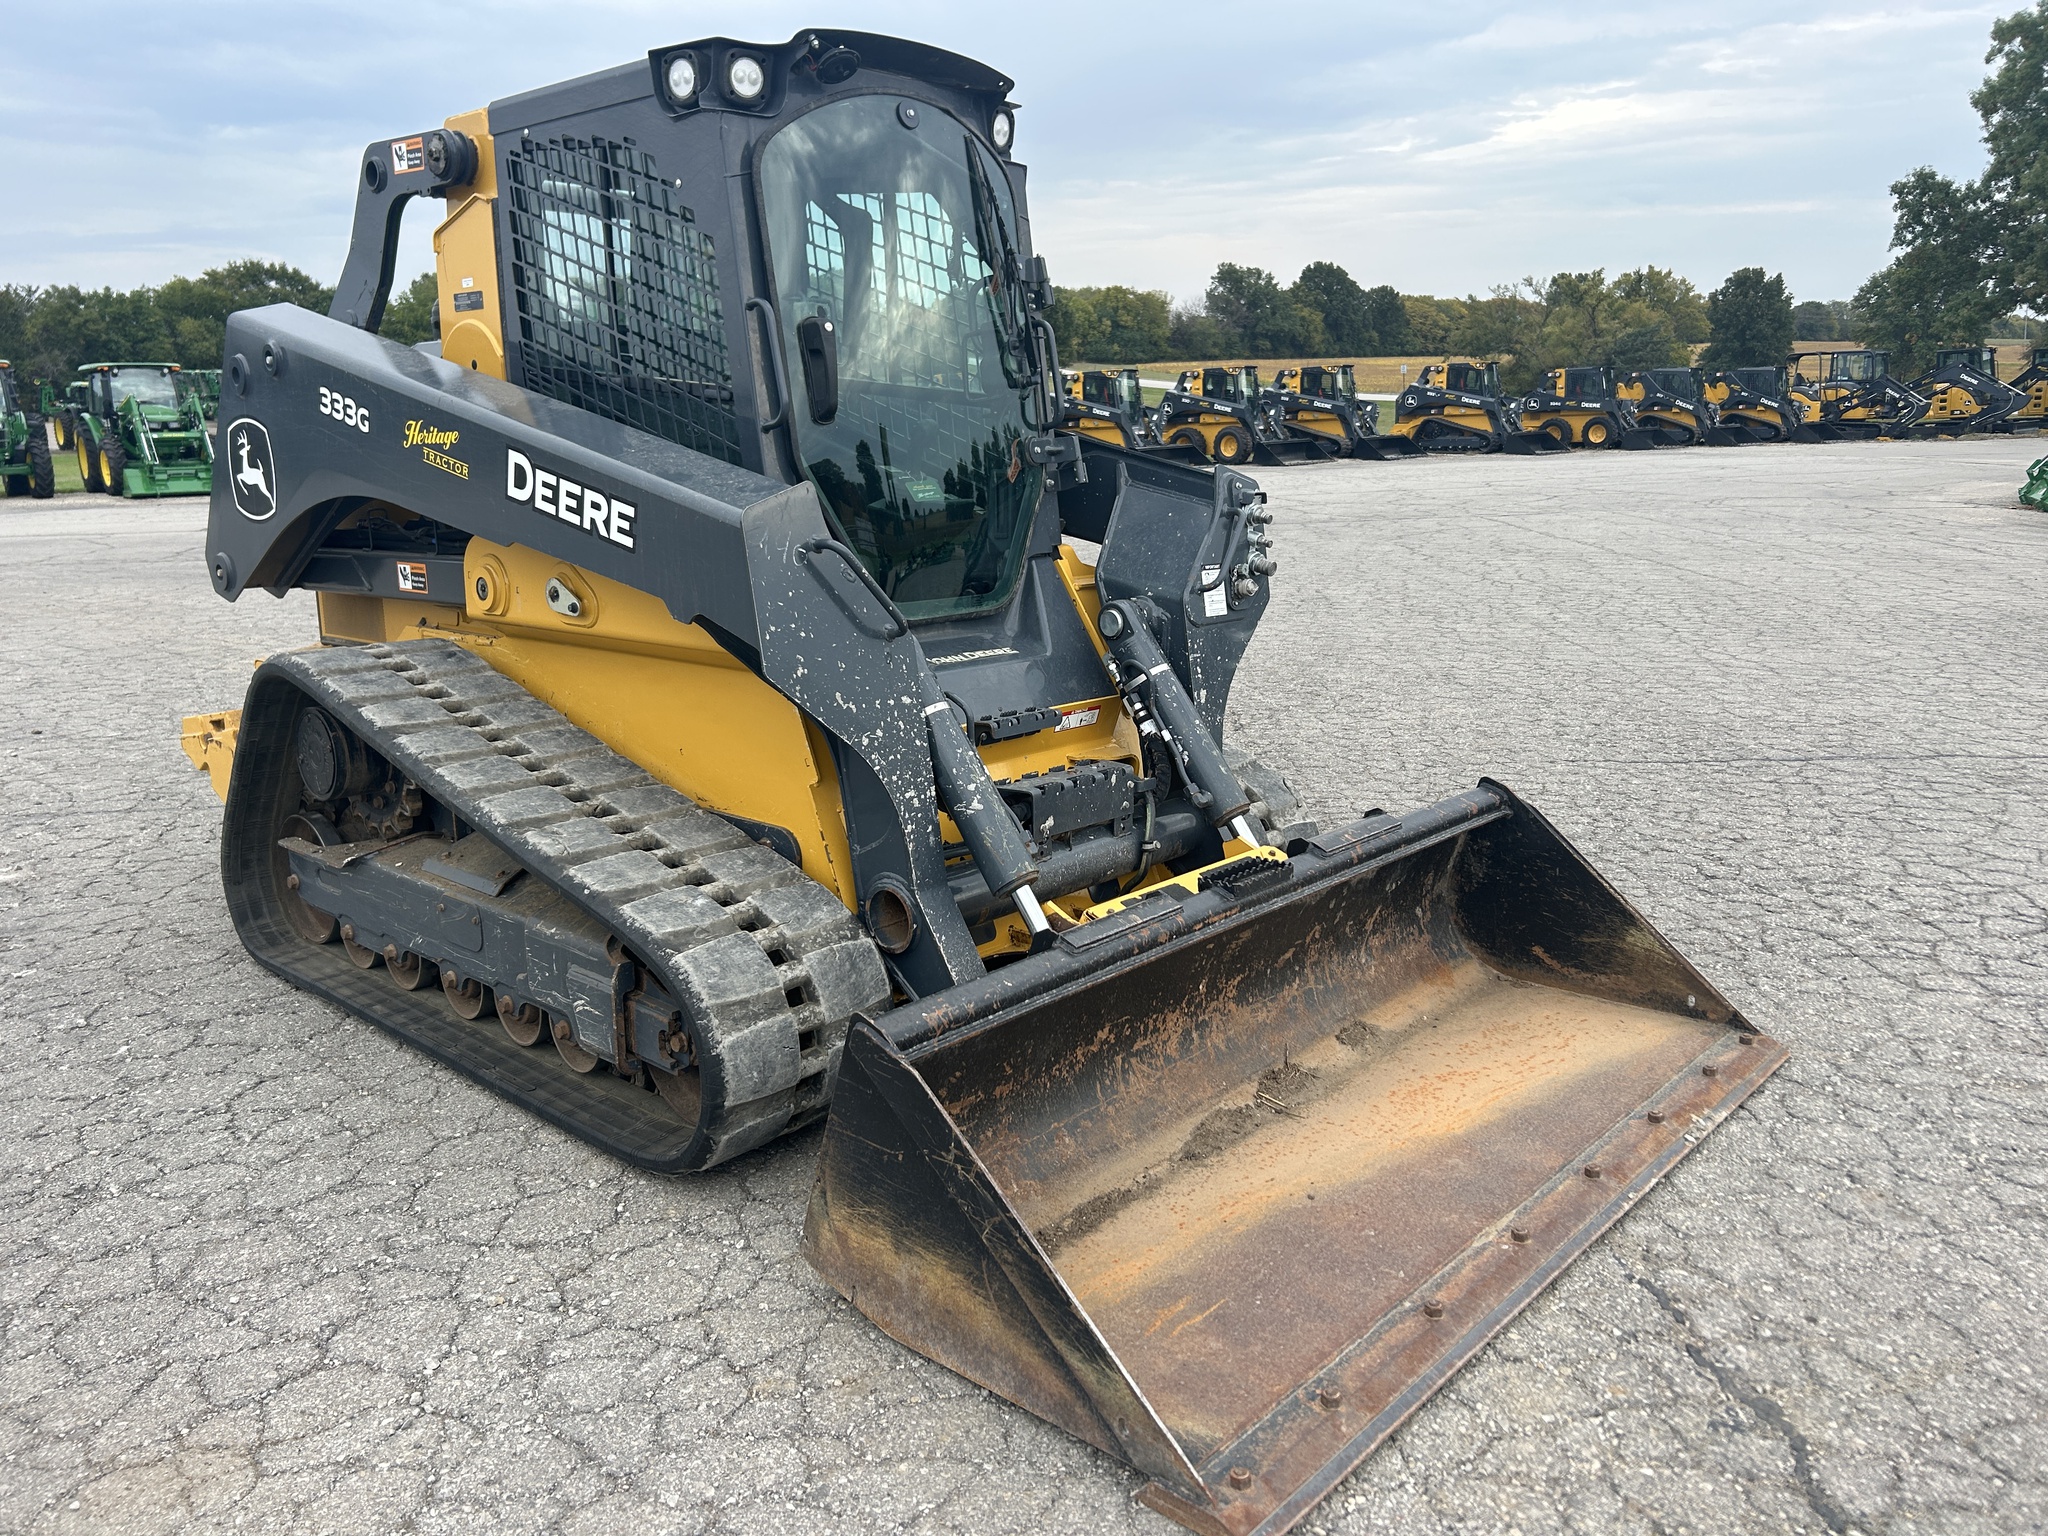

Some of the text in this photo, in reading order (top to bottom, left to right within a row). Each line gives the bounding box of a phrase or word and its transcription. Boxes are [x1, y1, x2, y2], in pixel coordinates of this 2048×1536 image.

[1960, 373, 1979, 385] DEERE
[1313, 400, 1333, 410] DEERE
[1461, 396, 1481, 405] DEERE
[1580, 401, 1601, 409] DEERE
[1675, 399, 1694, 411] DEERE
[1760, 397, 1779, 408] DEERE
[319, 386, 370, 433] 333G
[1092, 407, 1110, 417] DEERE
[1213, 403, 1233, 413] DEERE
[403, 419, 460, 450] Heritage
[422, 449, 469, 477] TRACTOR
[507, 448, 636, 549] DEERE
[963, 647, 1020, 661] DEERE
